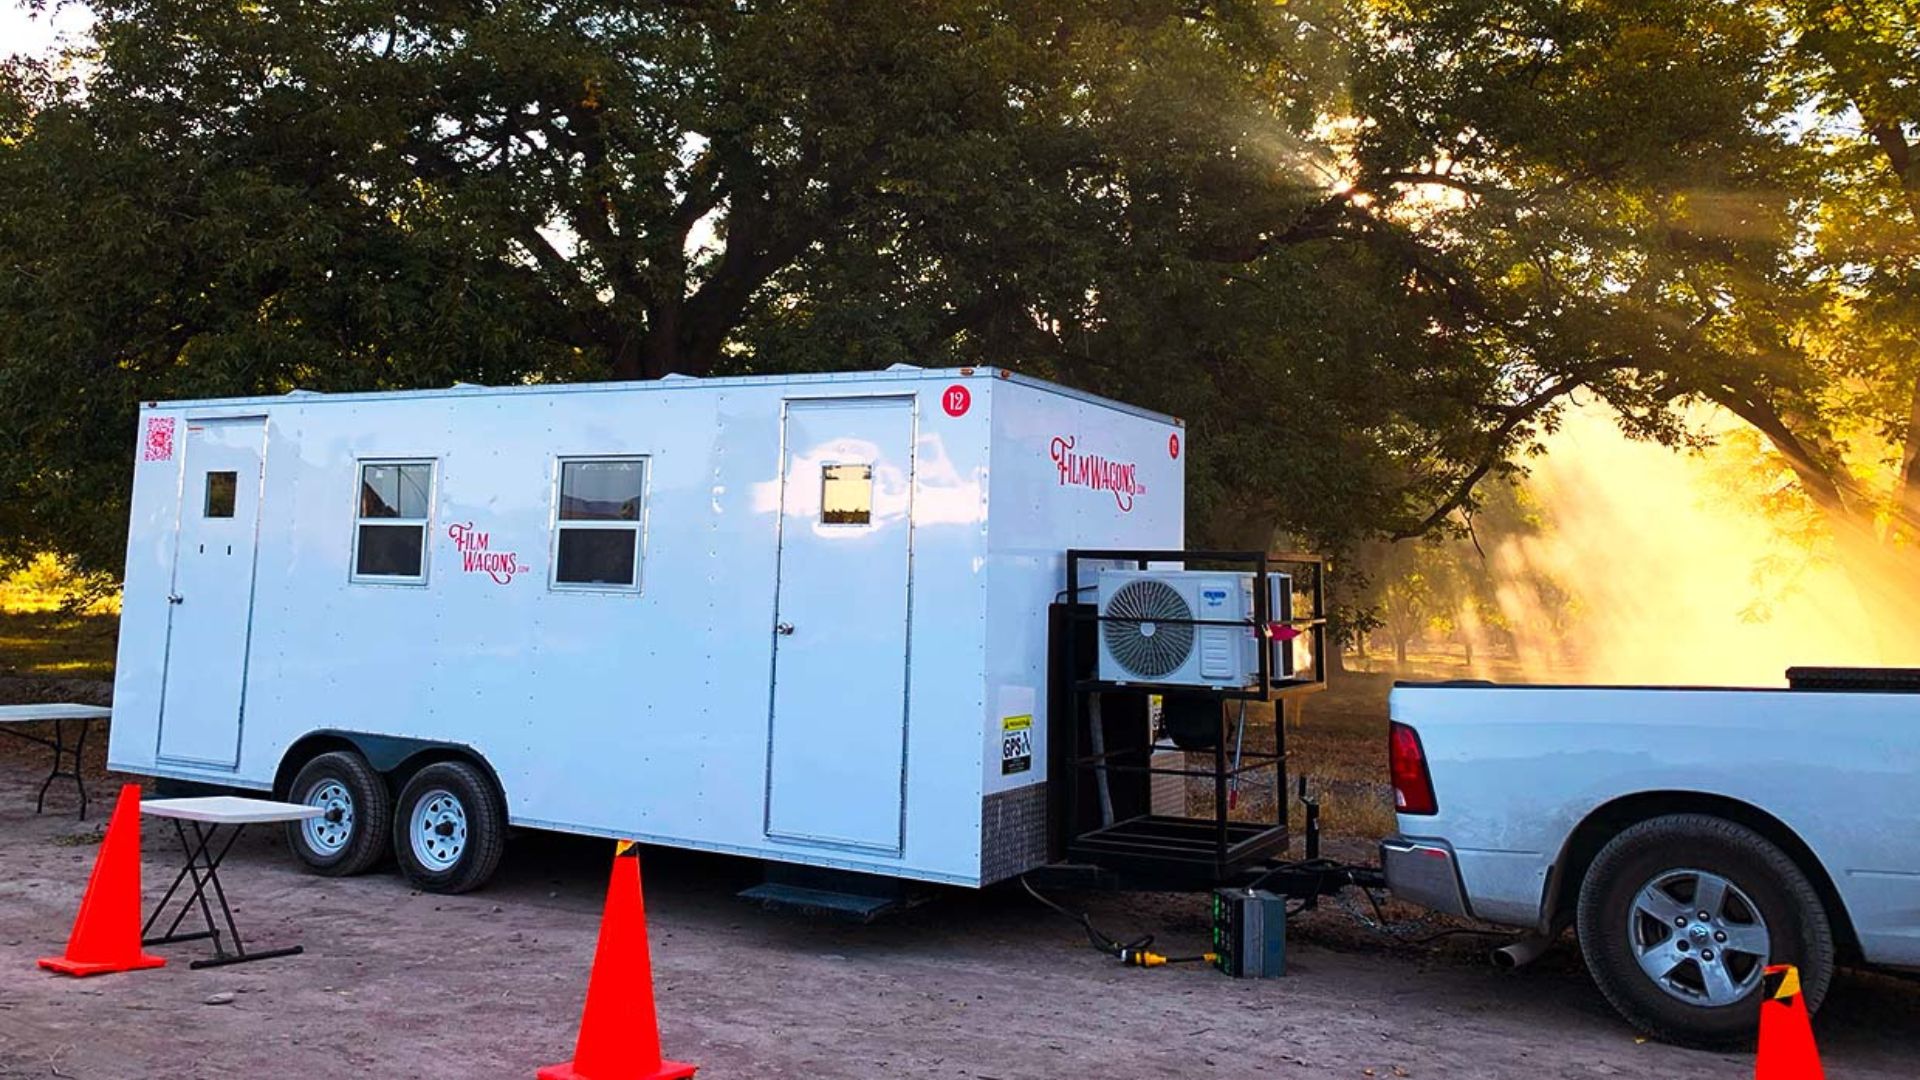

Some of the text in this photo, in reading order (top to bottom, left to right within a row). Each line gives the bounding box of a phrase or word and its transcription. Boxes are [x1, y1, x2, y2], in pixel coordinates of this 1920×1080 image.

[950, 392, 964, 410] 12
[449, 521, 489, 552] FILM
[1003, 736, 1021, 758] GPS
